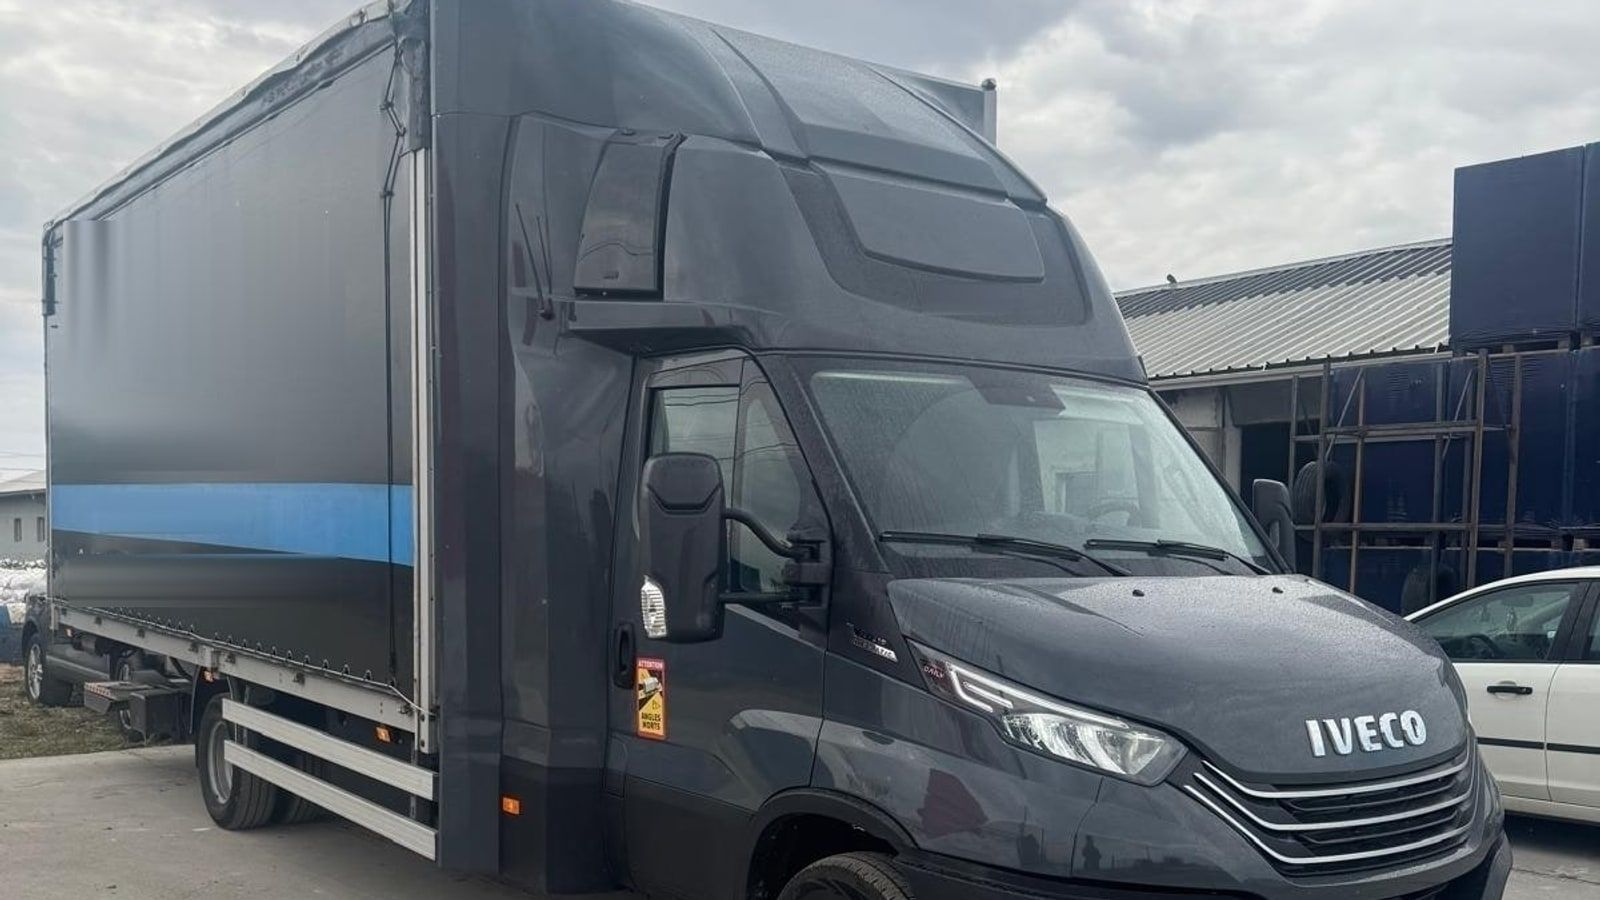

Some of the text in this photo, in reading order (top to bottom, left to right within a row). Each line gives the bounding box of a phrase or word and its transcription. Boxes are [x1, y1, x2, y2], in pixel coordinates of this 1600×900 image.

[923, 664, 944, 679] DAILY
[641, 712, 661, 721] ANGLES
[642, 721, 660, 730] MORTS
[1305, 709, 1427, 757] IVECO
